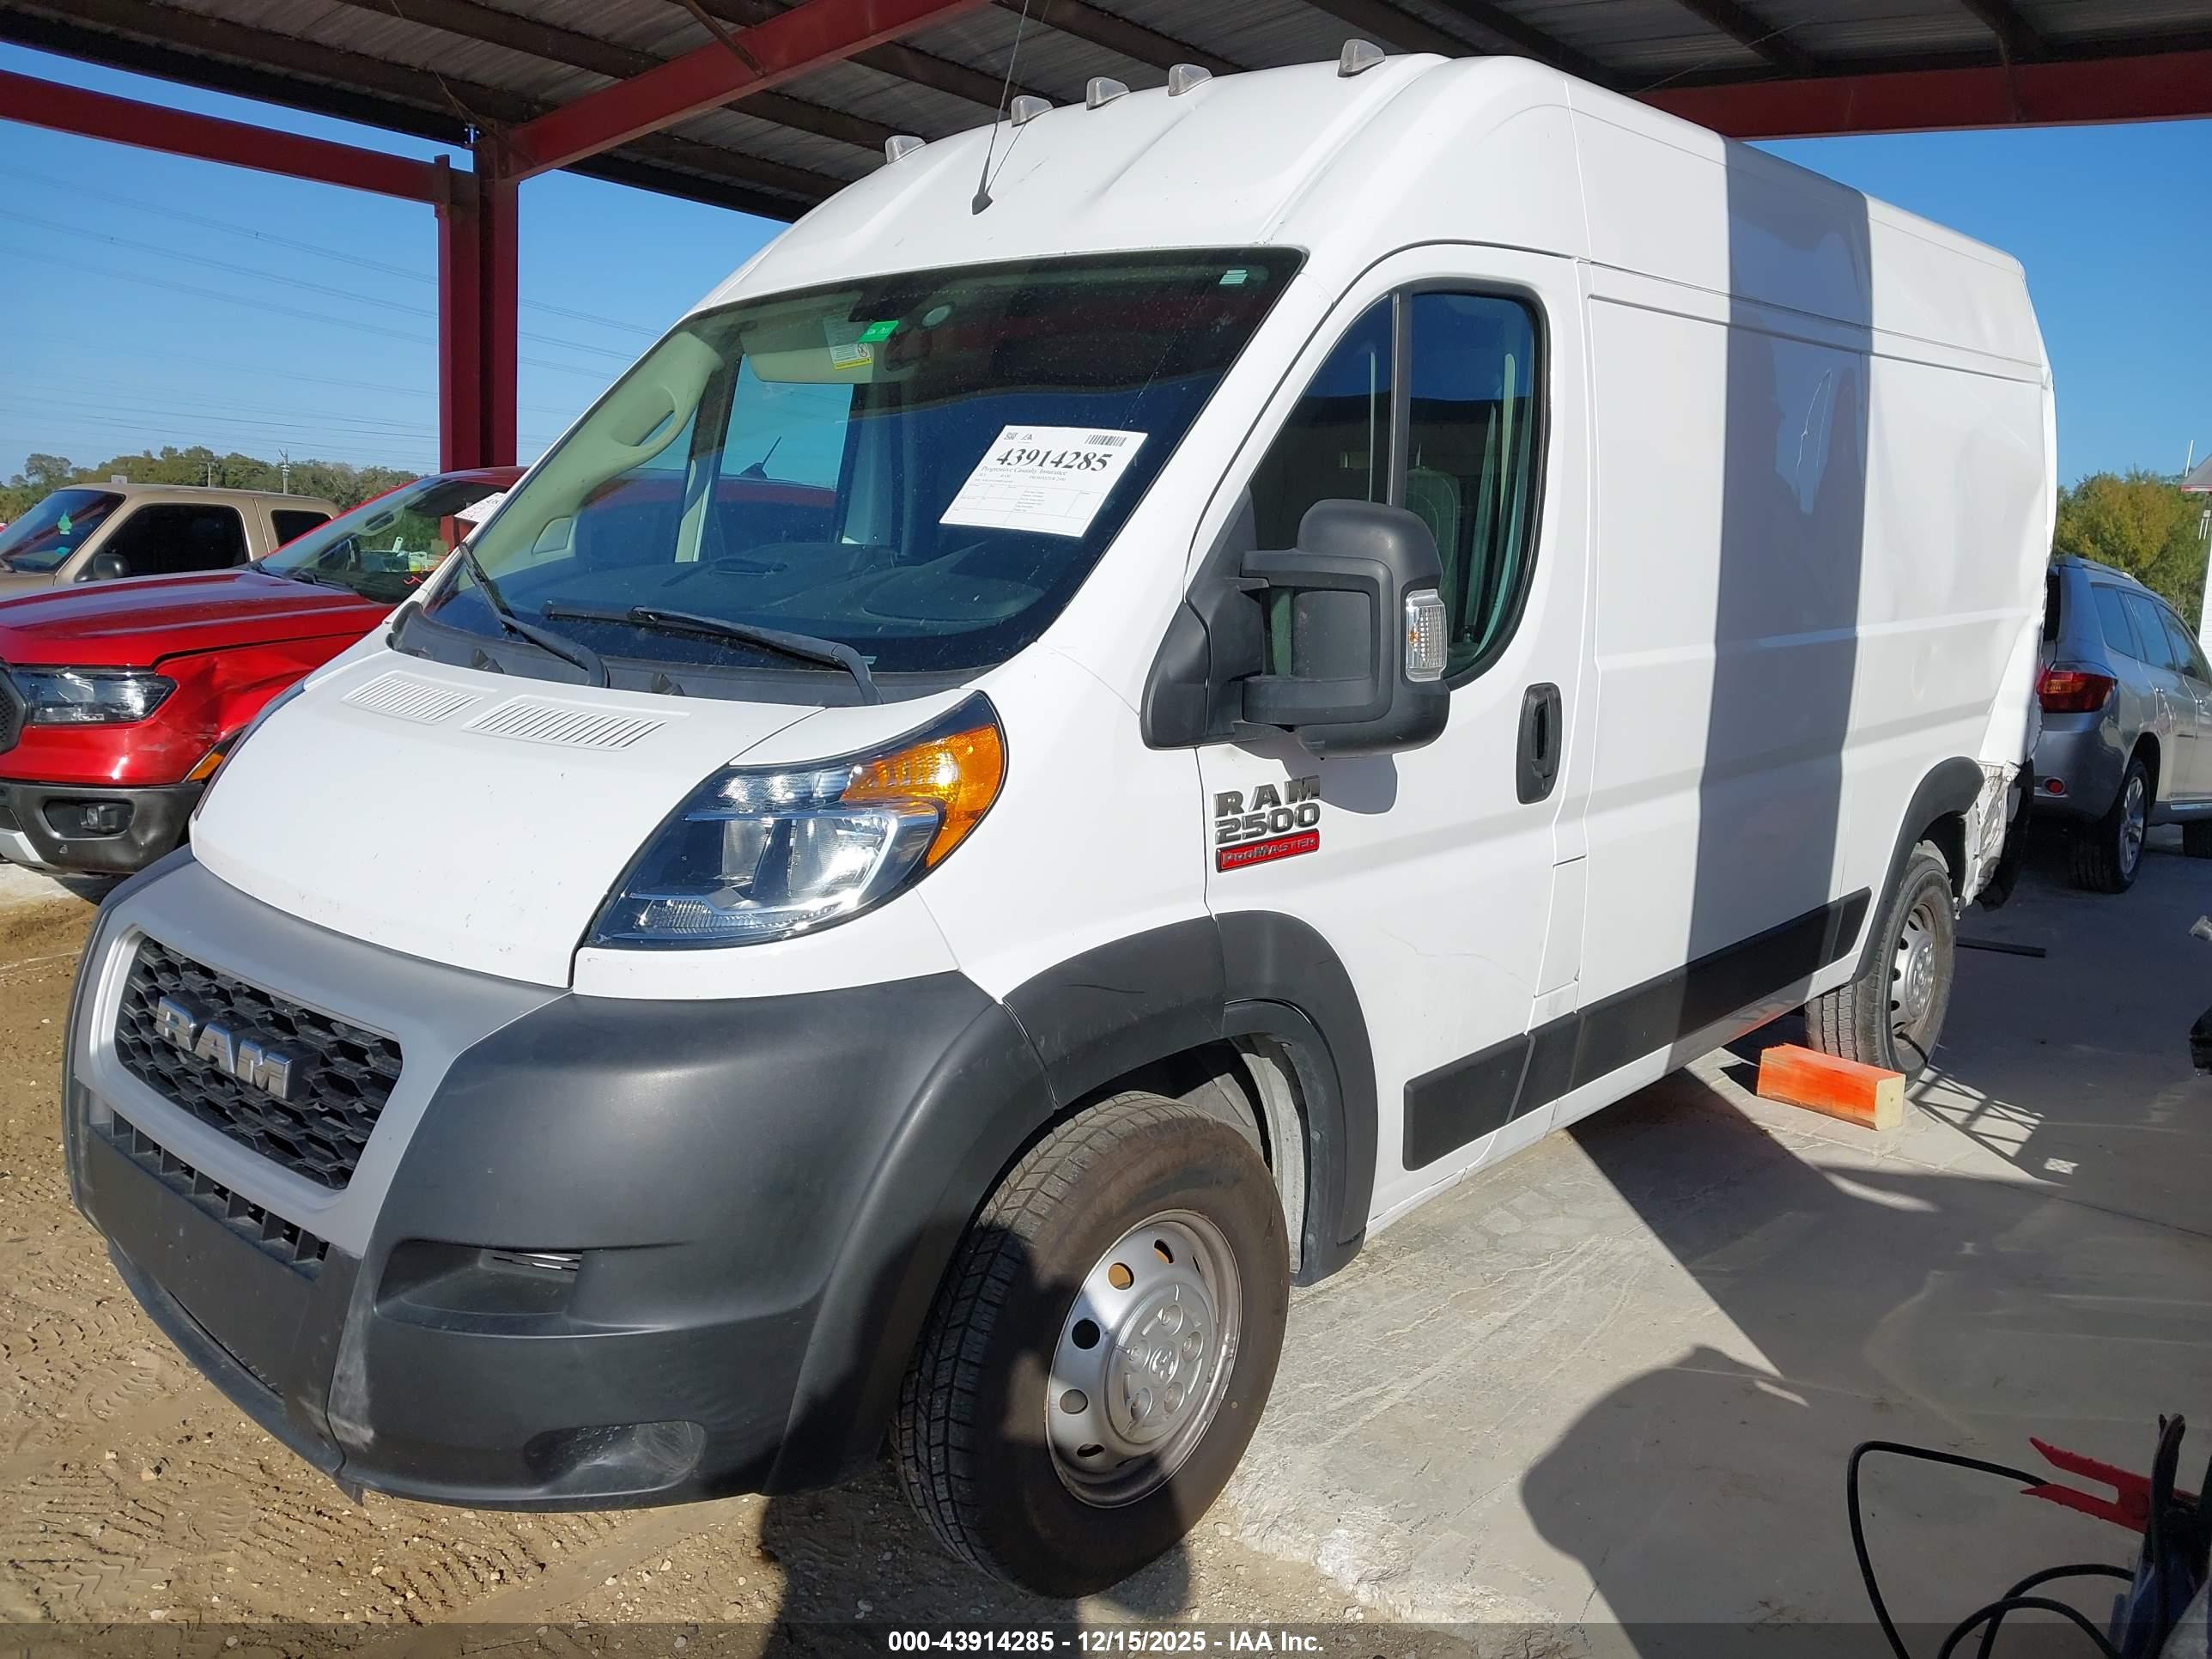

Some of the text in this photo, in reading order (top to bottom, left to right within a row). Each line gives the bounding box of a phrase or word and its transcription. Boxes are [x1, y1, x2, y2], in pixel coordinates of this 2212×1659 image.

[996, 447, 1113, 471] 43914285
[1213, 775, 1320, 817] RAM
[1215, 803, 1320, 845] 2500
[155, 995, 294, 1100] RAM
